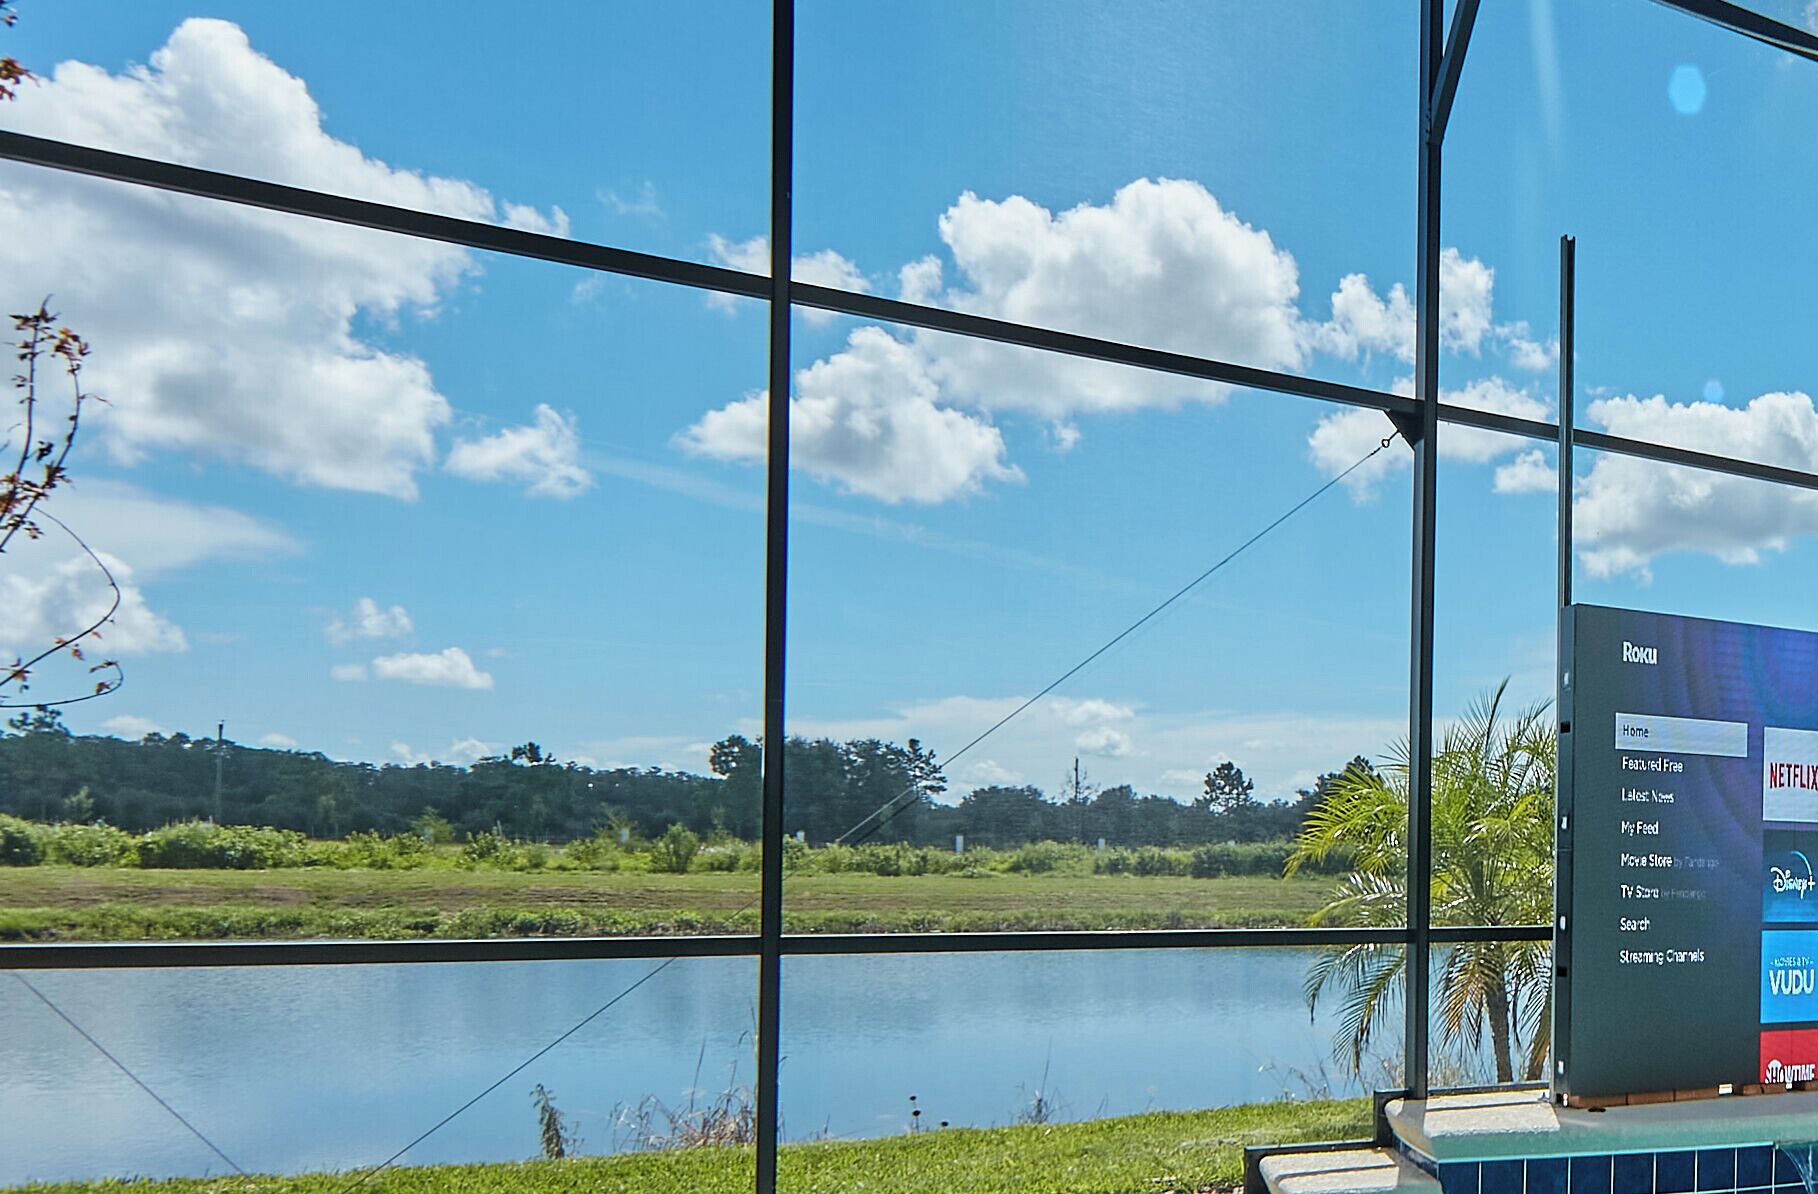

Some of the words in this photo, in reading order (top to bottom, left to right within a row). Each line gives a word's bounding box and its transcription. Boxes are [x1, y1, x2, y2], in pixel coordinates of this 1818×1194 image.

[1623, 641, 1657, 665] Roku
[1623, 724, 1649, 738] Home
[1622, 756, 1662, 772] Featured
[1663, 759, 1684, 773] Free
[1769, 762, 1818, 791] NETFLIX
[1621, 820, 1635, 836] My
[1636, 821, 1659, 835] Feed
[1649, 853, 1673, 868] Store
[1620, 884, 1634, 899] TV
[1620, 917, 1650, 931] Search
[1619, 950, 1664, 965] Streaming
[1666, 949, 1705, 963] Channels
[1769, 969, 1815, 995] VUDU
